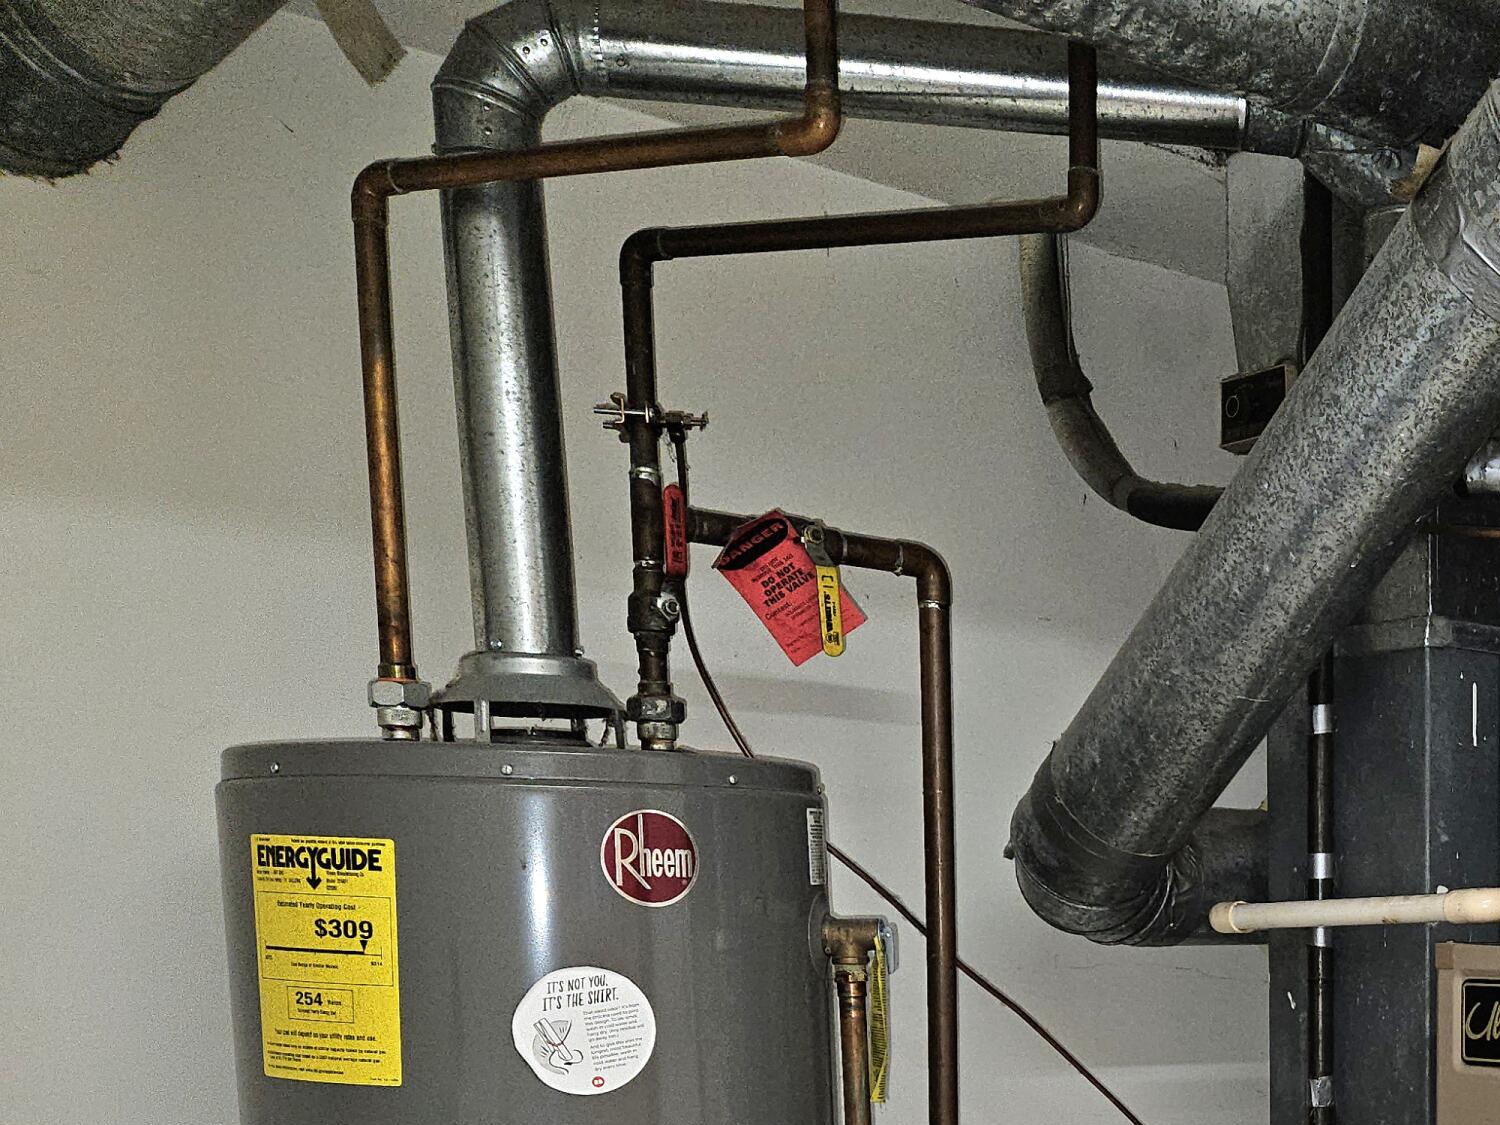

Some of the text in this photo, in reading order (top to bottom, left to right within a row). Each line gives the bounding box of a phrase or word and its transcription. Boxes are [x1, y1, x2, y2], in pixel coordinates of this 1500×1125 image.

[721, 523, 784, 566] DANGER
[761, 577, 776, 588] DO
[777, 563, 796, 579] NOT
[764, 568, 804, 597] OPERATE
[764, 571, 816, 607] THIS VALVE
[257, 845, 382, 871] ENERGYGUIDE
[614, 813, 692, 890] Rheem
[315, 918, 373, 939] $309
[547, 974, 608, 994] IT'S NOT YOU.
[295, 992, 323, 1006] 254
[542, 987, 619, 1011] IT'S THE SHIRT.
